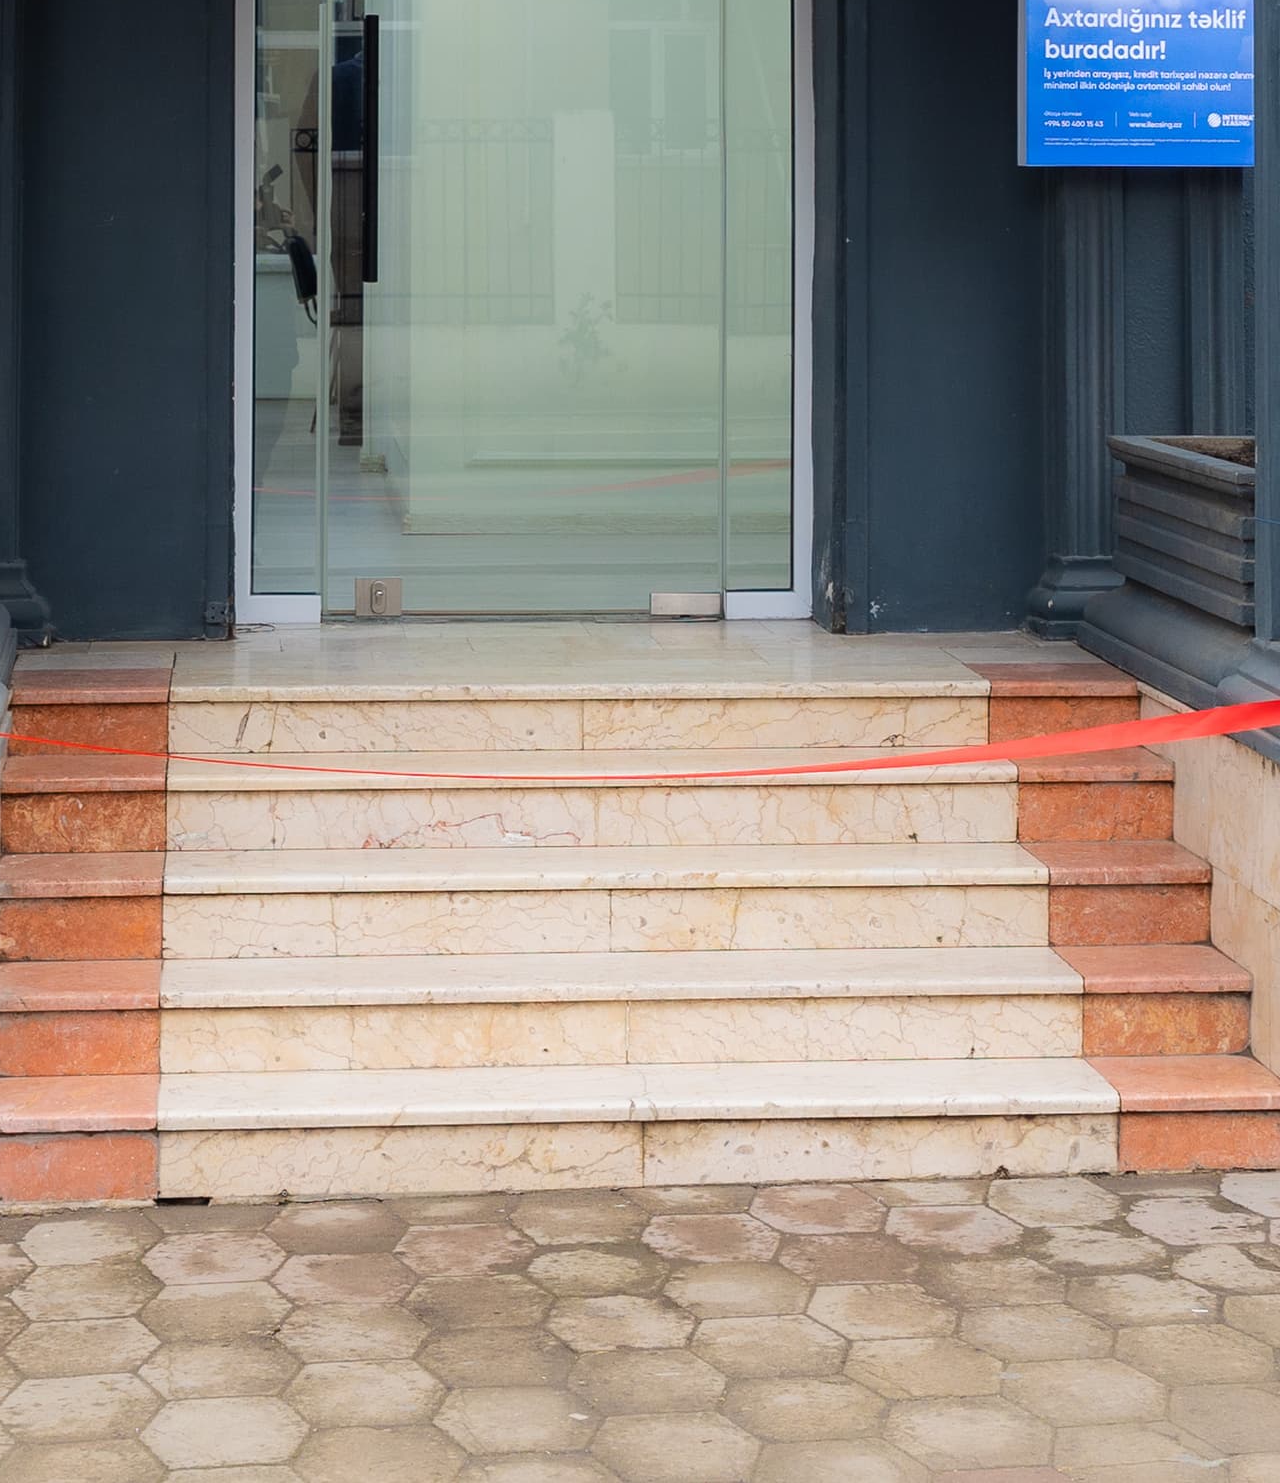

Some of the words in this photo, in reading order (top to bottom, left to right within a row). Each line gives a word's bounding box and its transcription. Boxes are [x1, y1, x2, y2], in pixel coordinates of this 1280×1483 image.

[1045, 7, 1183, 33] Axtardığınız
[1188, 8, 1247, 29] təklif
[1045, 39, 1166, 60] buradadır!
